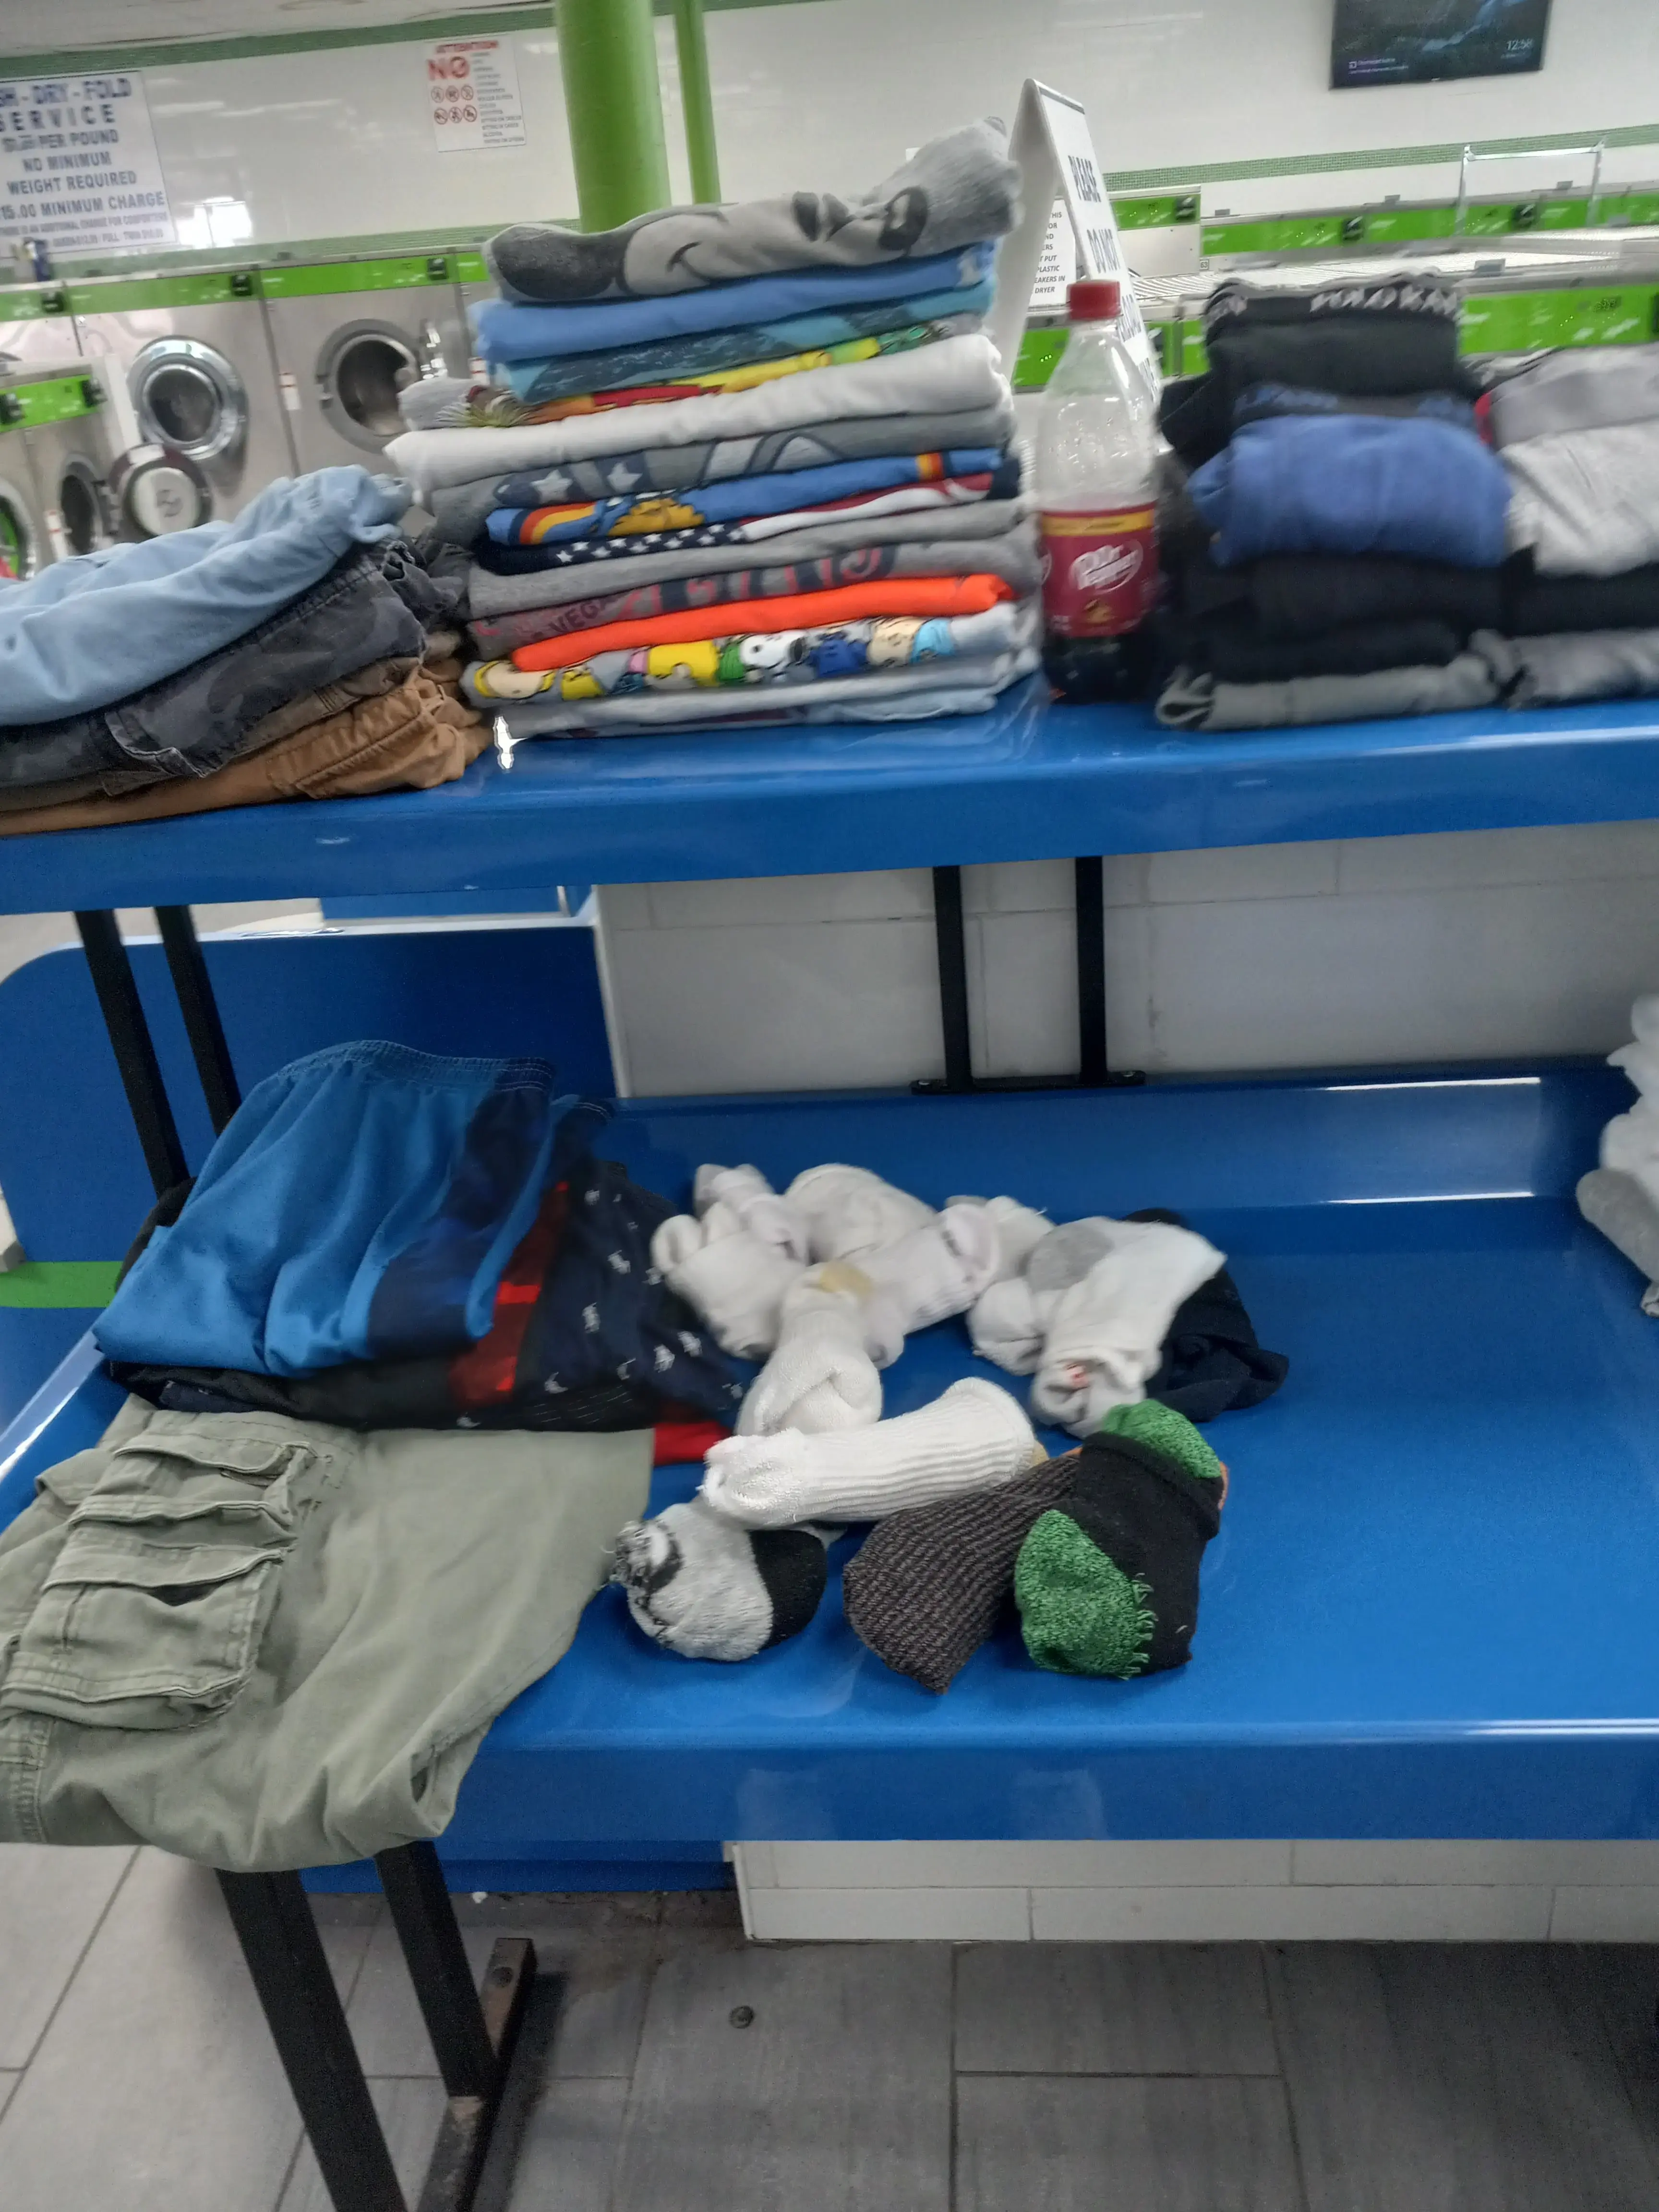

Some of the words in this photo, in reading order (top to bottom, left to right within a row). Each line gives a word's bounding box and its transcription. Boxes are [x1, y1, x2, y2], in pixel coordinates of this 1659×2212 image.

[429, 56, 469, 81] NO
[83, 78, 132, 101] FOLD
[70, 129, 119, 146] POUND
[23, 158, 43, 172] NO
[47, 151, 112, 170] MINIMUM
[7, 177, 62, 195] WEIGHT
[66, 170, 137, 191] REQUIRED
[40, 197, 103, 216] MINIMUM
[108, 191, 166, 210] CHARGE
